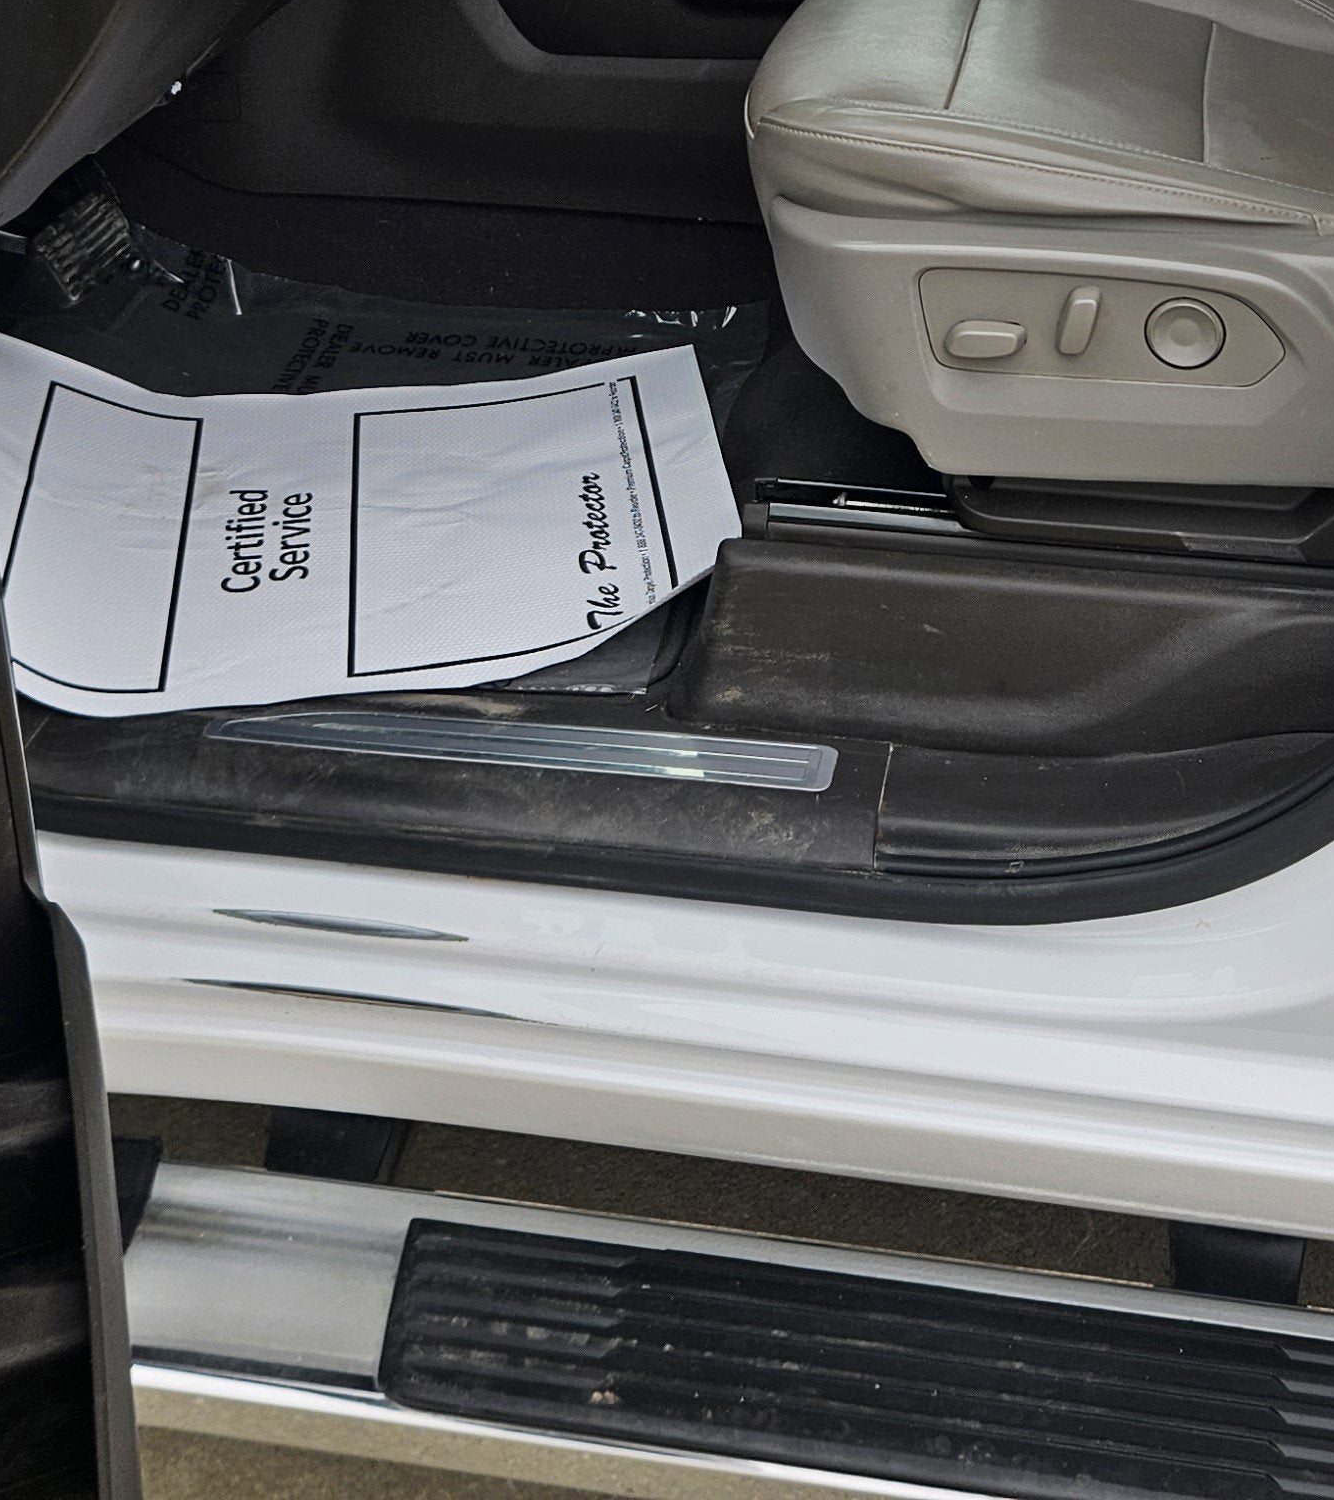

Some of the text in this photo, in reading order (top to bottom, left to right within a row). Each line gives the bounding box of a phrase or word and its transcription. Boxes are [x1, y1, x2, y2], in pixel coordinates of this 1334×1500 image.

[348, 340, 440, 360] REMOVE
[404, 331, 478, 348] COVER
[488, 334, 614, 357] PROTECTIVE
[453, 350, 515, 365] MUST
[616, 428, 631, 454] Protection
[620, 453, 632, 469] Carpet
[624, 469, 636, 491] Premium
[221, 489, 269, 593] Certified
[268, 492, 313, 582] Service
[578, 472, 624, 630] The Protector
